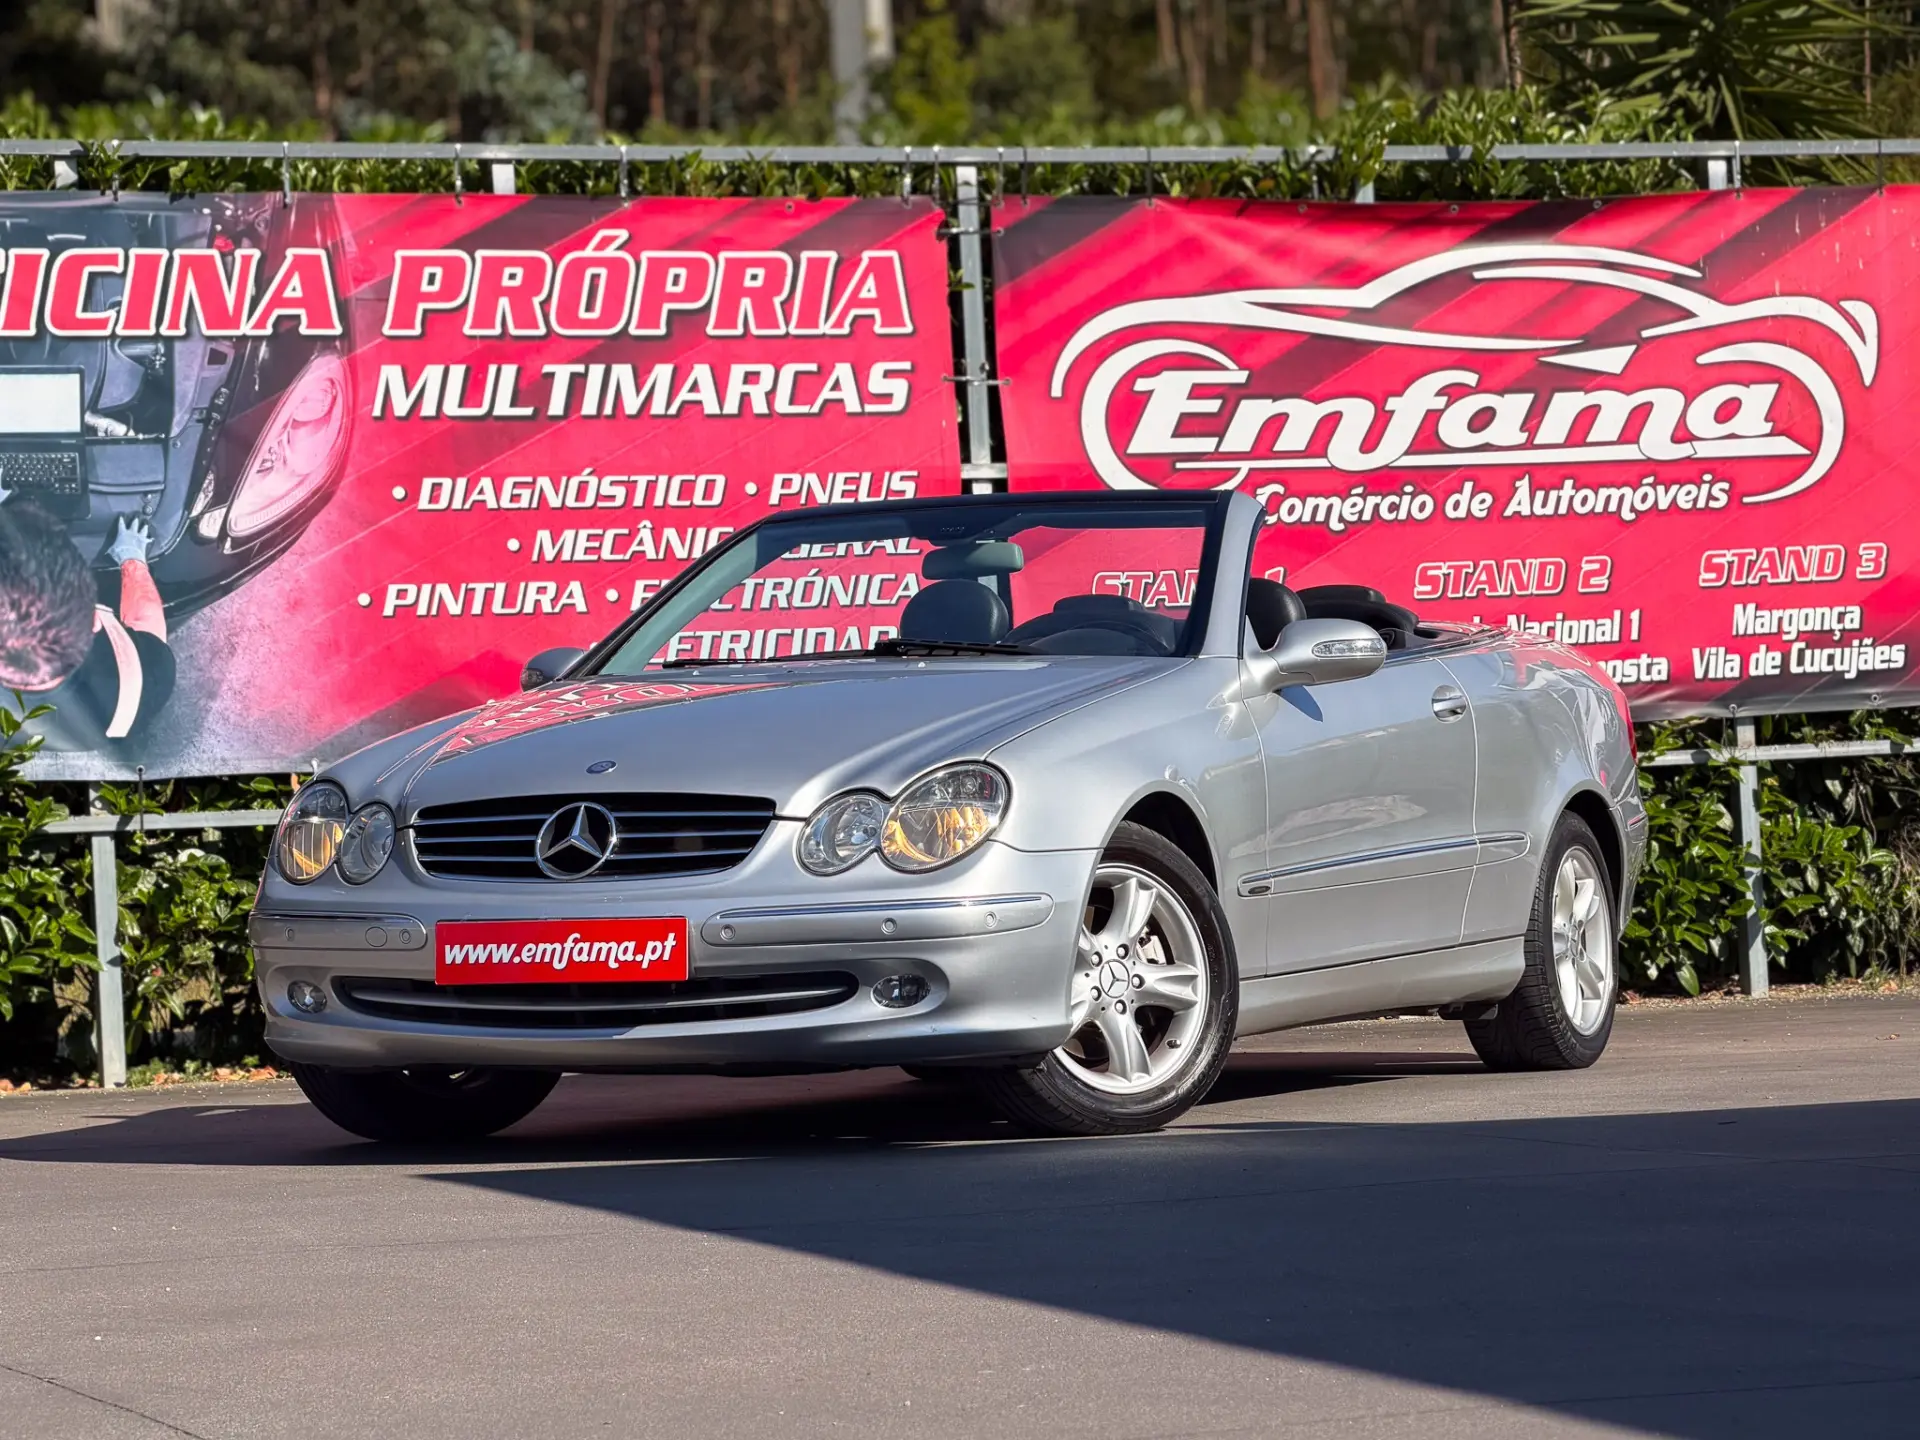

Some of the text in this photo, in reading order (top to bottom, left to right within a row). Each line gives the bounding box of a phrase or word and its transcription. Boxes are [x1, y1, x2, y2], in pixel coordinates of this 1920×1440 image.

[0, 229, 914, 337] ICINA PRÓPRIA
[372, 361, 914, 418] MULTIMARCAS
[1126, 370, 1780, 472] Emfama
[416, 468, 919, 511] DIAGNÓSTICO PNEUS
[1255, 474, 1730, 531] Comércio de Automóveis
[531, 520, 735, 563] MECÂNIC
[1414, 556, 1612, 600] STAND 2
[1699, 542, 1888, 587] STAND 3
[382, 580, 588, 617] PINTURA
[1630, 608, 1641, 641] 1
[1733, 604, 1861, 640] Margonça
[1692, 637, 1905, 679] Vila de Cucujães
[444, 932, 677, 970] www.emfama.pt
